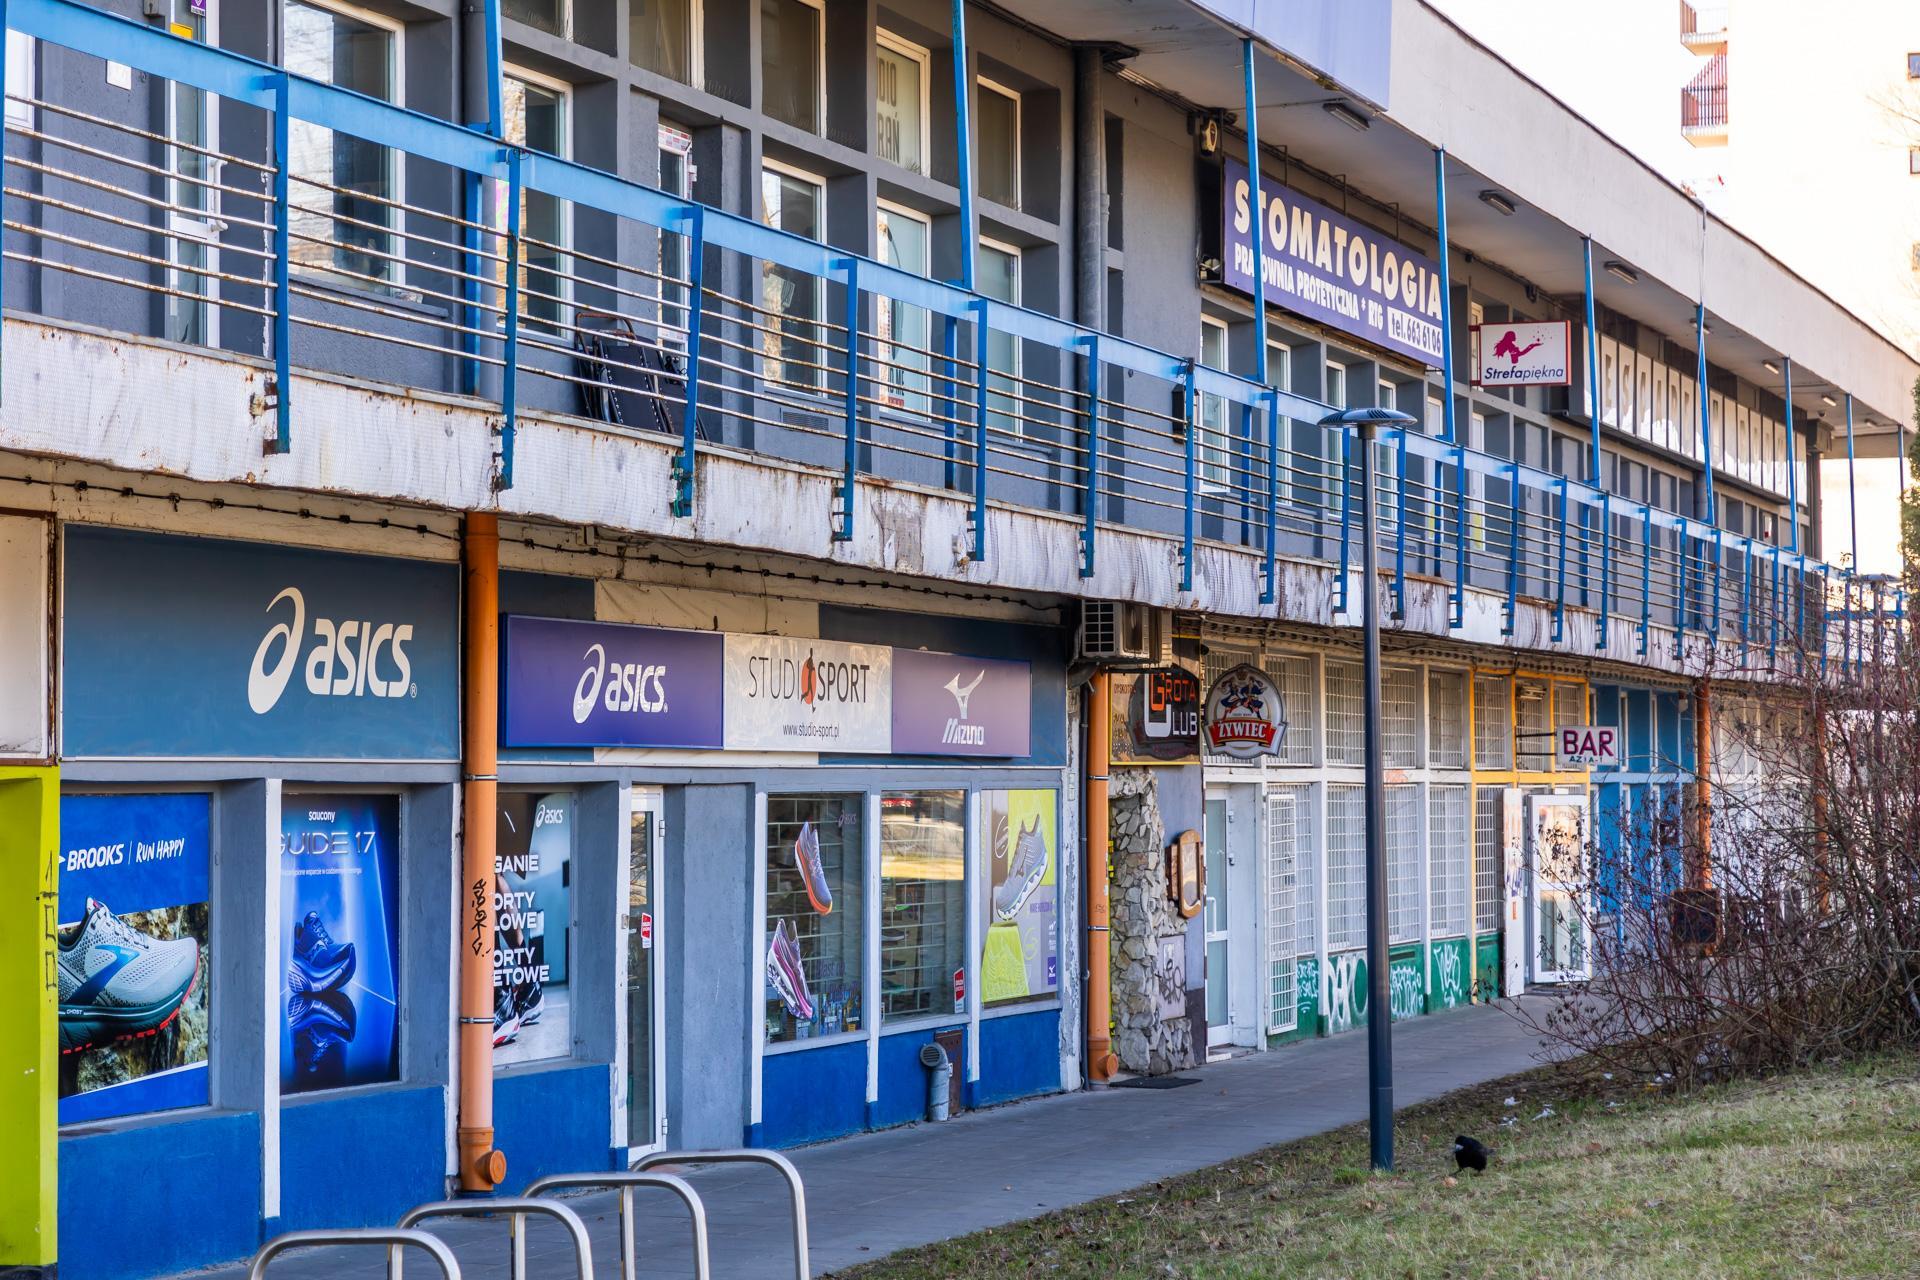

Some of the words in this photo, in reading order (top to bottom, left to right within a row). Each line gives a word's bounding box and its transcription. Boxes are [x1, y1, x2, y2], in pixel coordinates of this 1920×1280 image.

[876, 58, 896, 107] DIO
[1234, 179, 1443, 321] STOMATOLOGIA
[1234, 242, 1295, 294] PRAOWNIA
[1297, 269, 1360, 321] PROTETYCZNA
[1368, 299, 1384, 331] RTG
[1484, 365, 1564, 381] Strefapiękna
[817, 660, 870, 704] SPORT
[1150, 672, 1196, 711] GROTA
[783, 721, 840, 741] www.studio-sport.pl
[1563, 730, 1614, 757] BAR
[308, 810, 336, 823] saucony
[67, 843, 124, 871] BROOKS
[136, 841, 154, 863] RUN
[157, 837, 185, 861] HAPPY
[355, 831, 376, 853] 17
